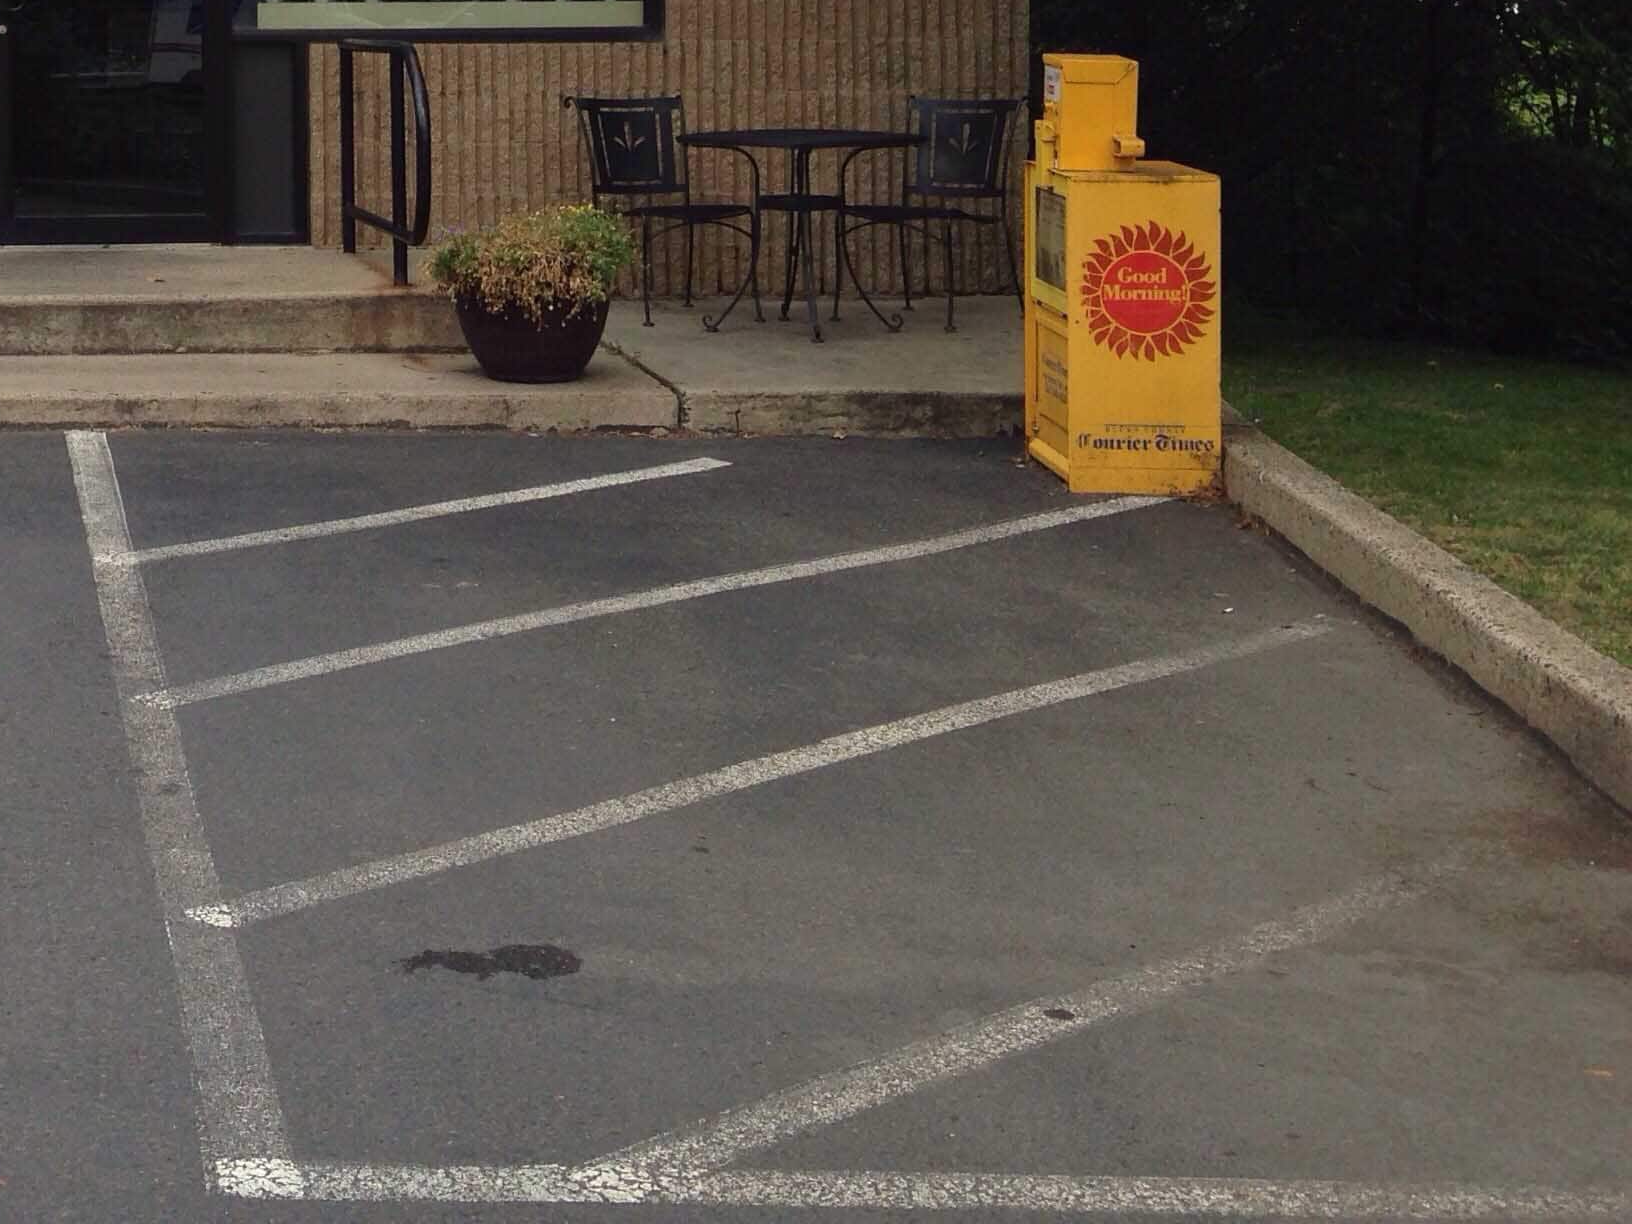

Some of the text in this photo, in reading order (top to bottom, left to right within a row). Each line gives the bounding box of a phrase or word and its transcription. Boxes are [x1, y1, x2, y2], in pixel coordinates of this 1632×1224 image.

[1117, 265, 1168, 284] Good
[1103, 283, 1187, 305] Morning!
[1155, 433, 1215, 453] Times
